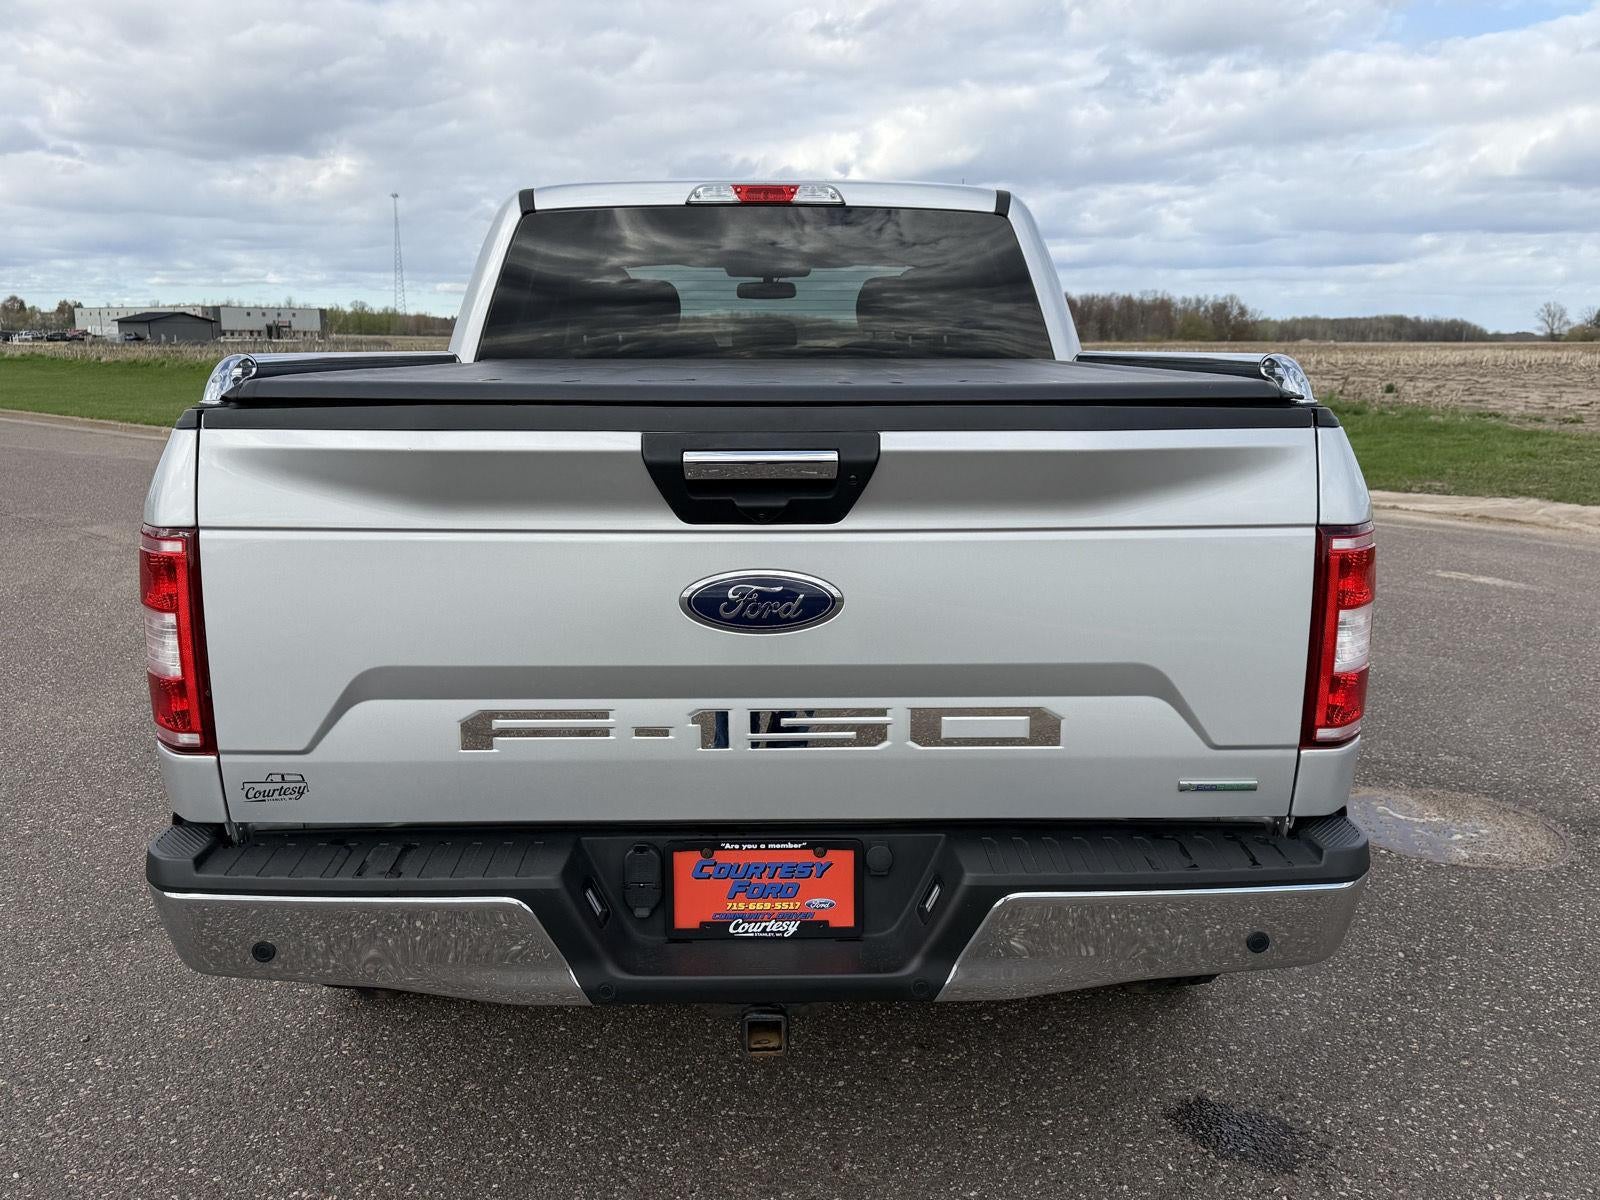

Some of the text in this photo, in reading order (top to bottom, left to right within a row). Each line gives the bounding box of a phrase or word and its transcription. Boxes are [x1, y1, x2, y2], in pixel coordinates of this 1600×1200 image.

[719, 584, 805, 620] Ford
[459, 708, 1065, 753] F-150
[245, 785, 307, 801] Courtesy
[742, 843, 758, 851] you
[692, 859, 833, 879] COURTESY
[727, 880, 800, 899] FORD
[726, 901, 801, 911] 715-669-5517
[810, 899, 831, 909] Ford
[712, 912, 775, 920] COMMUNITY
[728, 919, 801, 937] Courtesy
